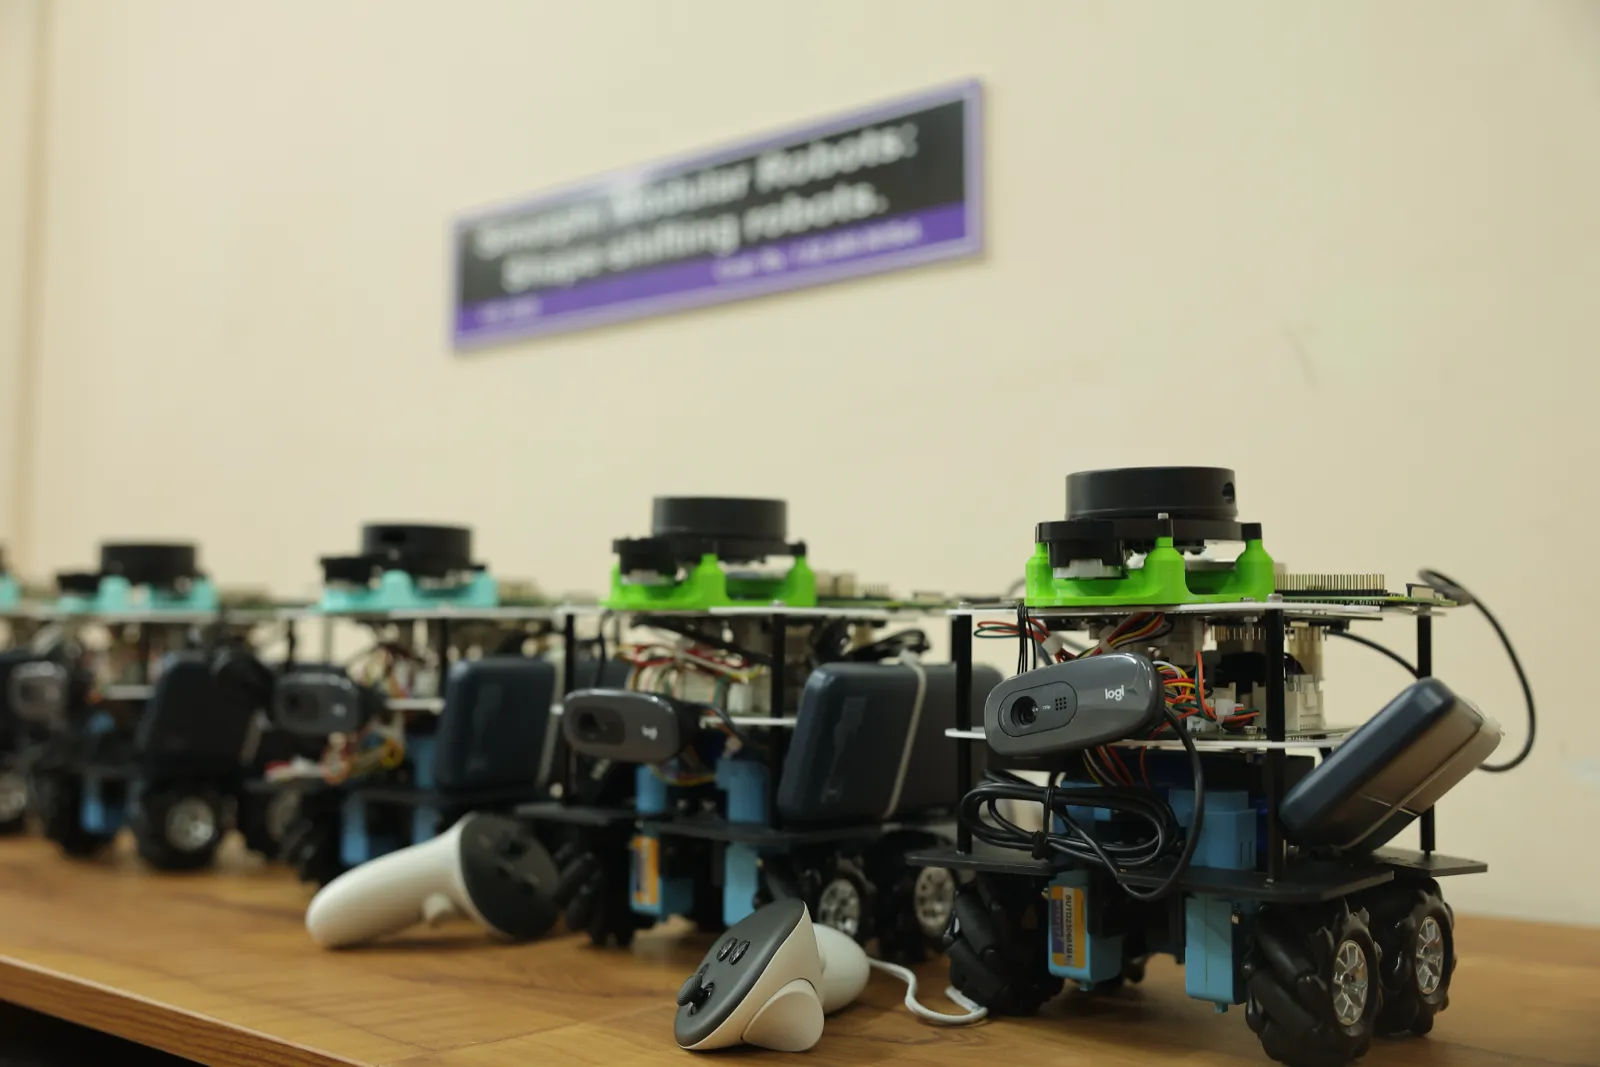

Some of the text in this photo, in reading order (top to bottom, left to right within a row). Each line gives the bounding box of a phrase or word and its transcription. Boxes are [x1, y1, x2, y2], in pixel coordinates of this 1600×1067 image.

[609, 164, 749, 221] Modular
[756, 125, 918, 193] Robots:
[744, 183, 888, 241] robots.
[1104, 684, 1125, 701] logi
